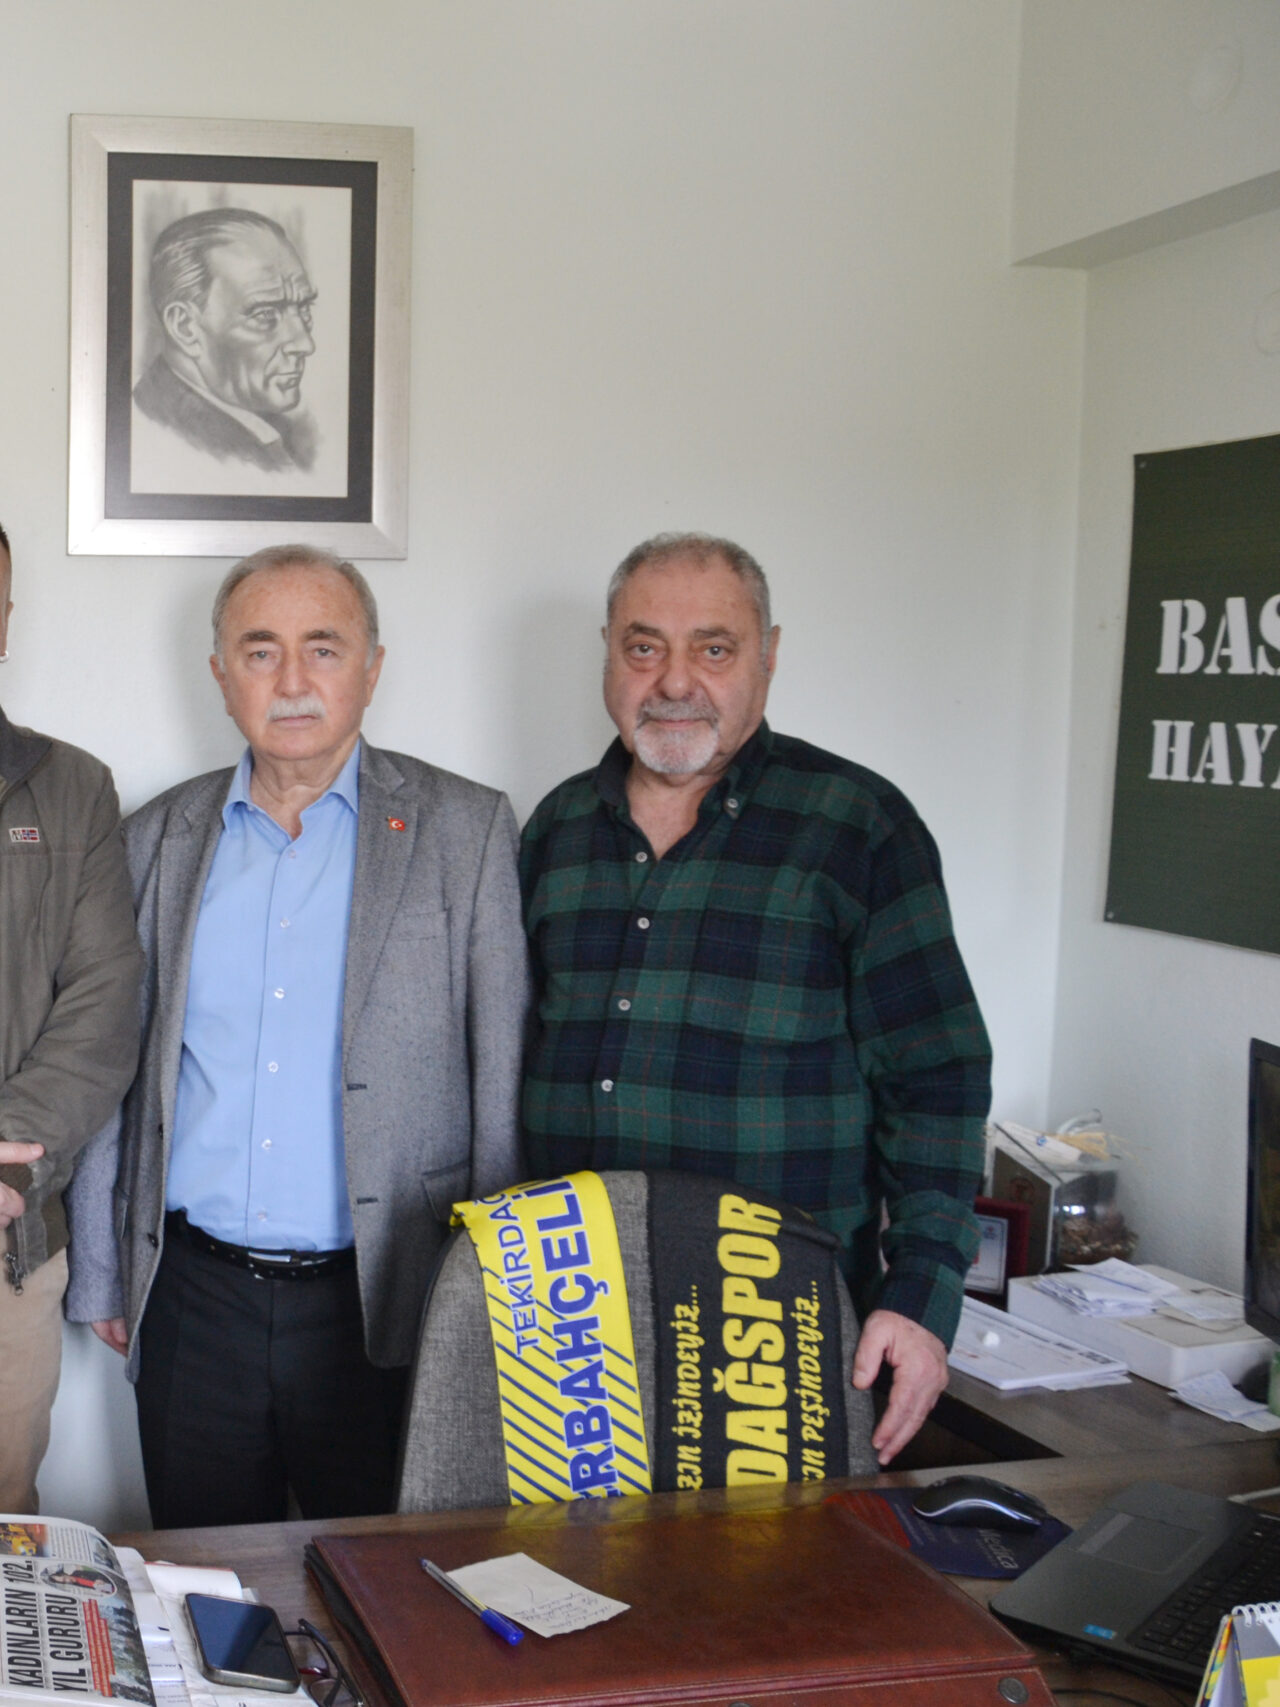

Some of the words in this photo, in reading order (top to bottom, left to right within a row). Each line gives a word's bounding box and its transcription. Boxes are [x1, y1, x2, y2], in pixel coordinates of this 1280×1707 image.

[1156, 593, 1280, 675] BAS
[1148, 720, 1280, 789] HAY
[510, 1176, 620, 1500] RBAHÇELİ
[711, 1193, 789, 1488] DAĞSPOR
[801, 1448, 826, 1481] IN
[2, 1560, 35, 1584] 102.
[4, 1587, 44, 1688] KADINLARIN
[45, 1593, 85, 1662] GURURU
[51, 1668, 89, 1692] YIL
